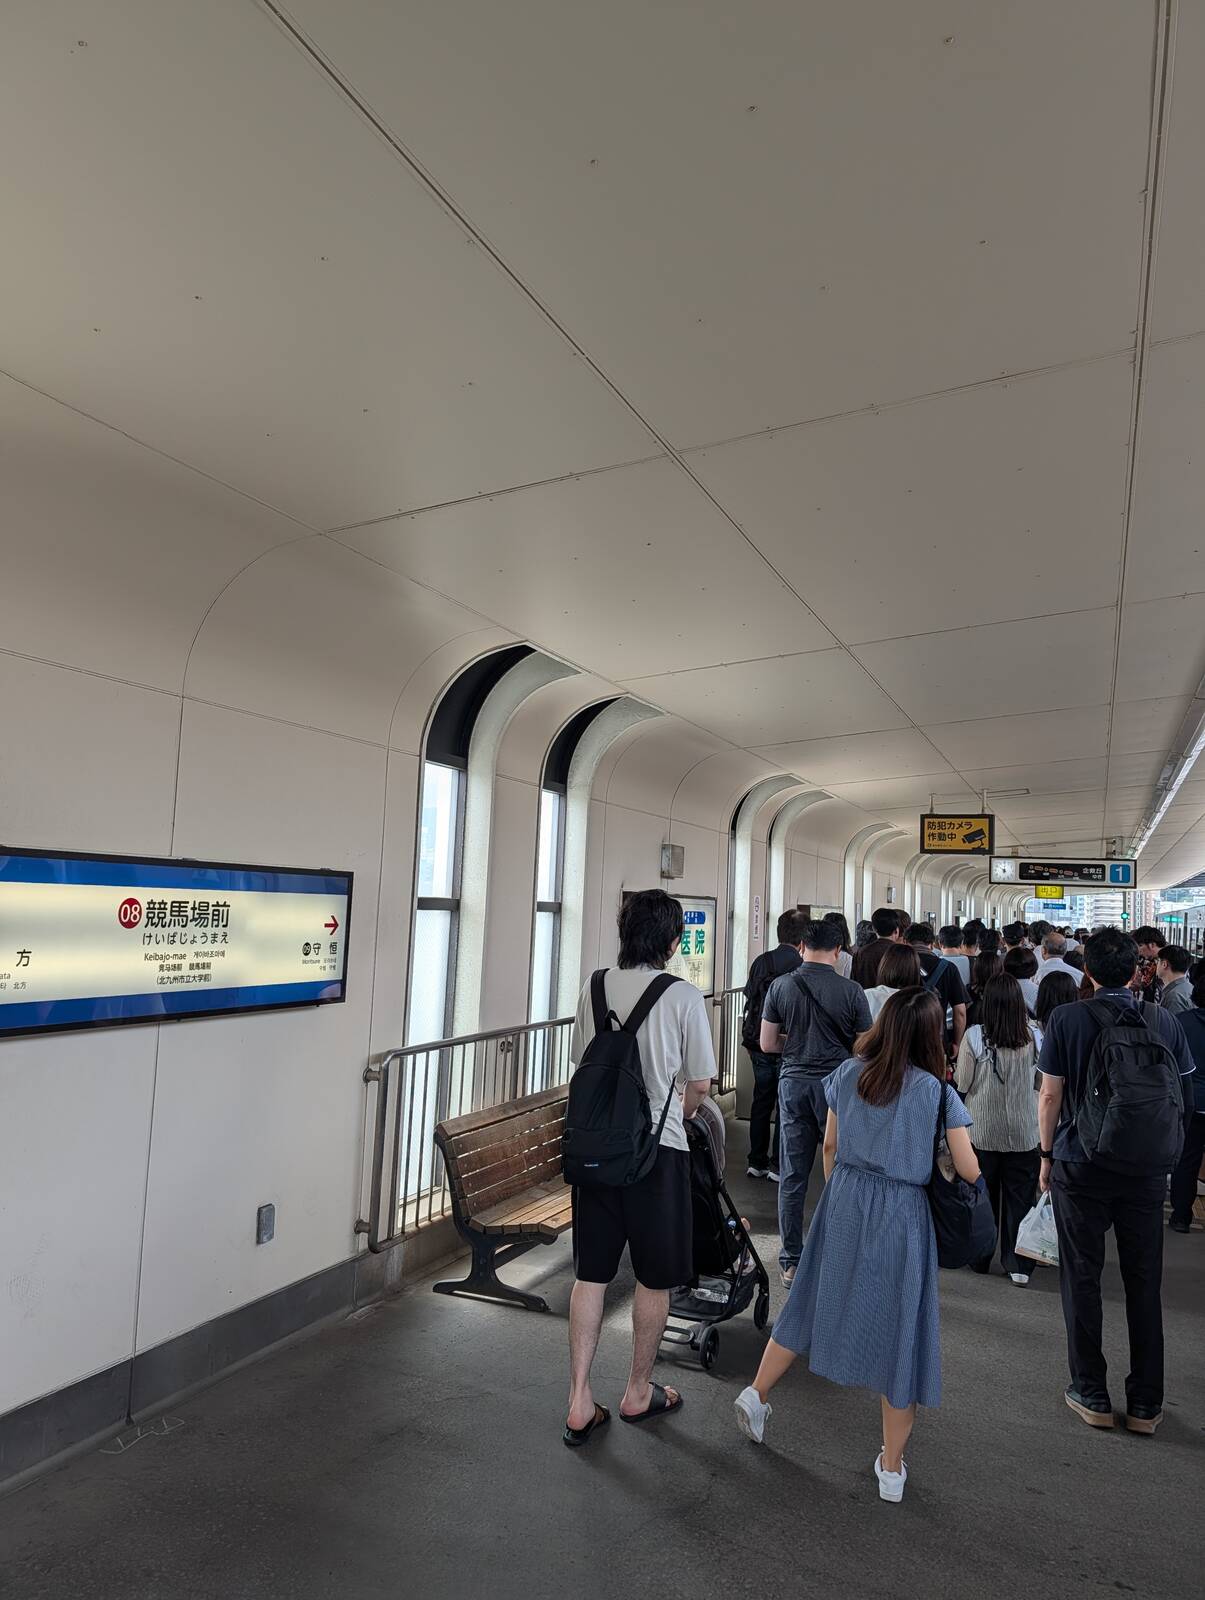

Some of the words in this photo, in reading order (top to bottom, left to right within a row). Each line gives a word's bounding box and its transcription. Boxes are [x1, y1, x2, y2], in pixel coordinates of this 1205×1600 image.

[927, 821, 973, 830] 防犯カメラ
[927, 832, 957, 841] 作動中
[1115, 866, 1123, 882] 1
[121, 904, 140, 922] 08
[144, 899, 231, 928] 競馬場前
[143, 932, 229, 945] けいばじょうまえ
[313, 943, 321, 955] 守
[330, 942, 337, 954] 恒
[16, 949, 32, 966] 方
[144, 952, 187, 963] Keibajo-mae
